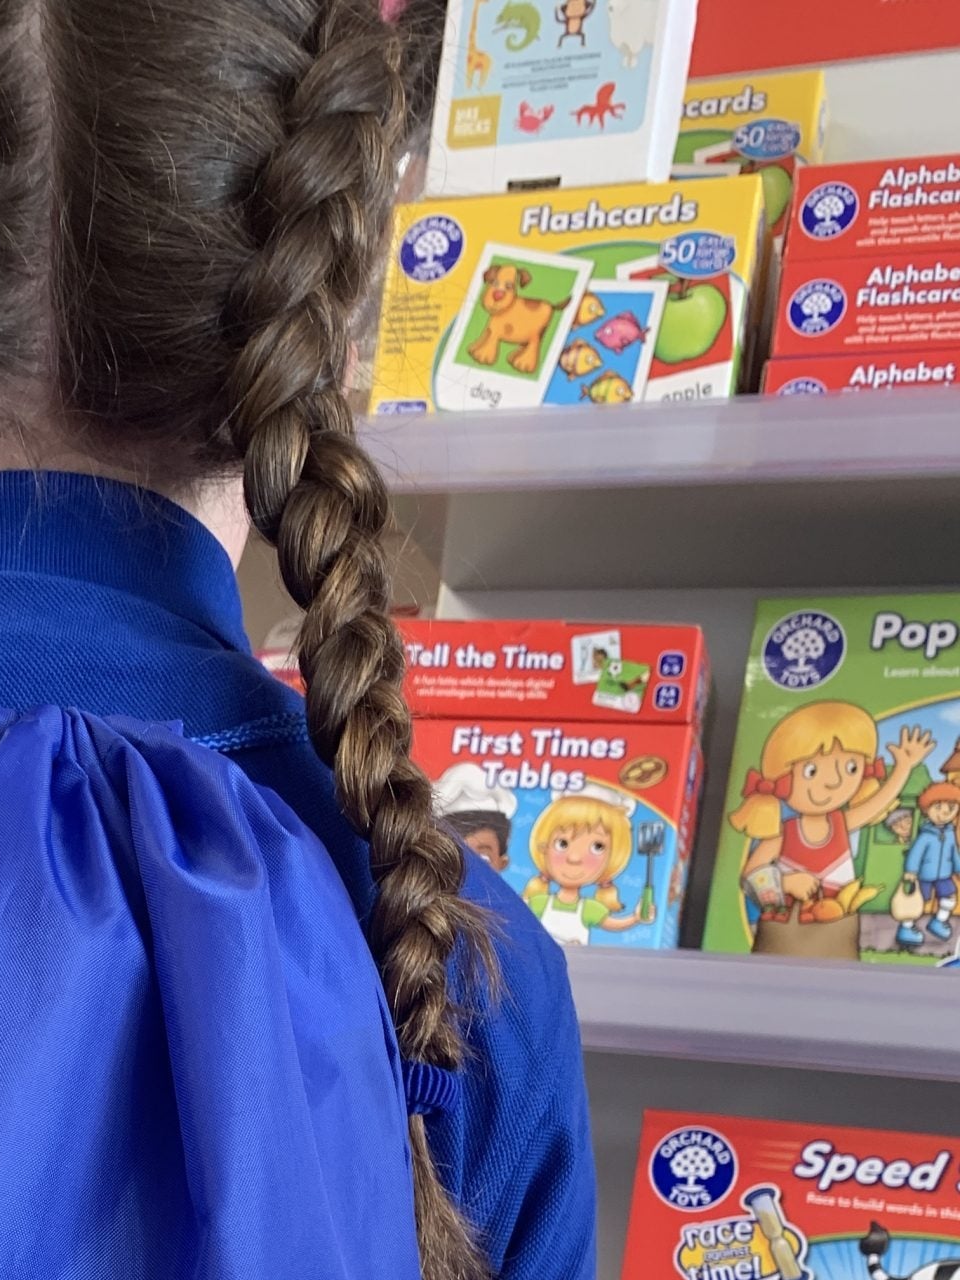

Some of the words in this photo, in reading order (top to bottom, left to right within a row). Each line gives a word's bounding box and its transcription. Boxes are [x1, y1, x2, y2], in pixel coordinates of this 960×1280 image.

[735, 126, 765, 148] 50
[879, 162, 960, 191] Alphab
[868, 186, 960, 210] Flashcar
[520, 193, 698, 237] Flashcards
[662, 238, 695, 265] 50
[866, 262, 960, 290] Alphabe
[849, 361, 956, 389] Alphabet
[470, 382, 503, 407] dog
[772, 614, 840, 643] ORCHARD
[871, 611, 958, 660] Pop
[406, 643, 450, 669] Tell
[455, 643, 496, 669] the
[501, 644, 565, 671] Time
[780, 669, 821, 688] TOYS
[451, 726, 523, 757] First
[530, 728, 626, 760] Times
[481, 760, 586, 792] Tables
[660, 1131, 731, 1166] ORCHARD
[793, 1139, 951, 1192] Speed
[668, 1187, 712, 1207] TOYS
[806, 1192, 836, 1208] Race
[837, 1194, 851, 1209] to
[852, 1197, 885, 1213] build
[886, 1201, 924, 1218] words
[925, 1202, 938, 1218] in
[682, 1219, 753, 1249] race
